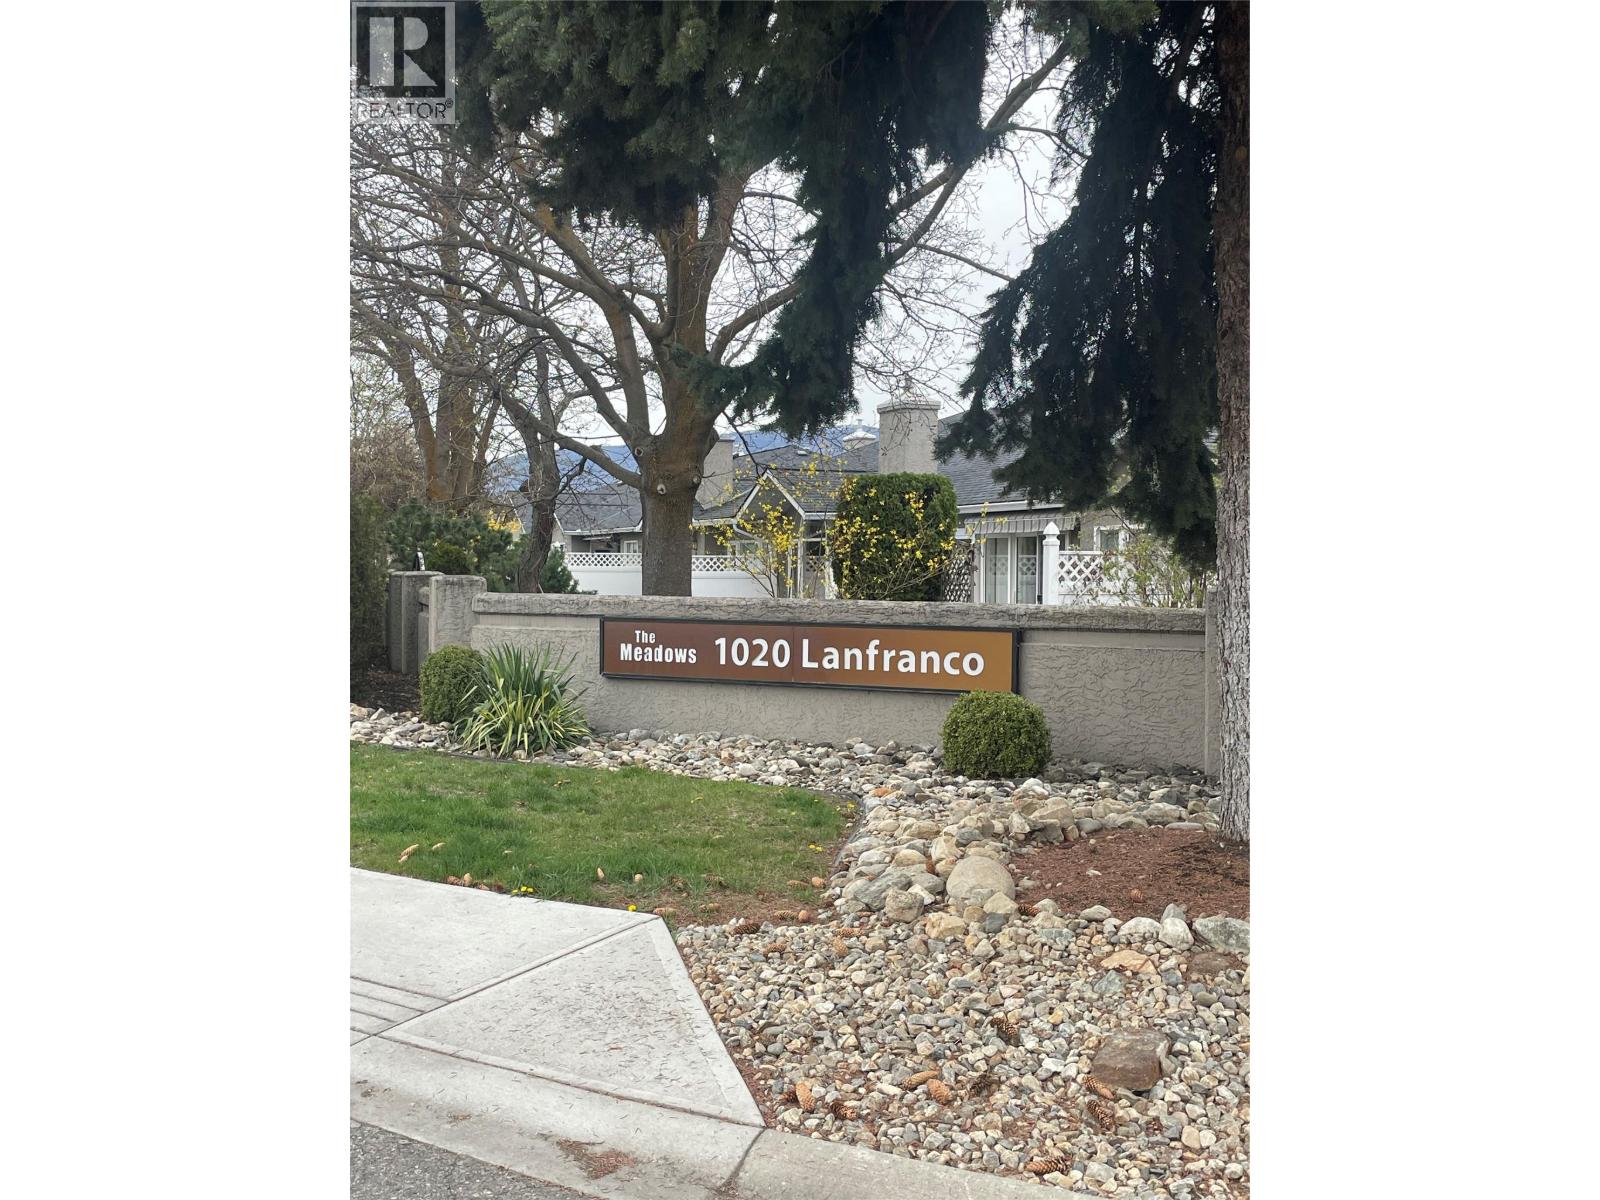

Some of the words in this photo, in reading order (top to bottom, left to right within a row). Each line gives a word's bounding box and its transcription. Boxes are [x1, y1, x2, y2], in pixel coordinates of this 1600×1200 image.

[634, 630, 656, 644] The
[620, 643, 697, 664] Meadows
[714, 637, 791, 668] 1020
[801, 638, 985, 676] Lanfranco
